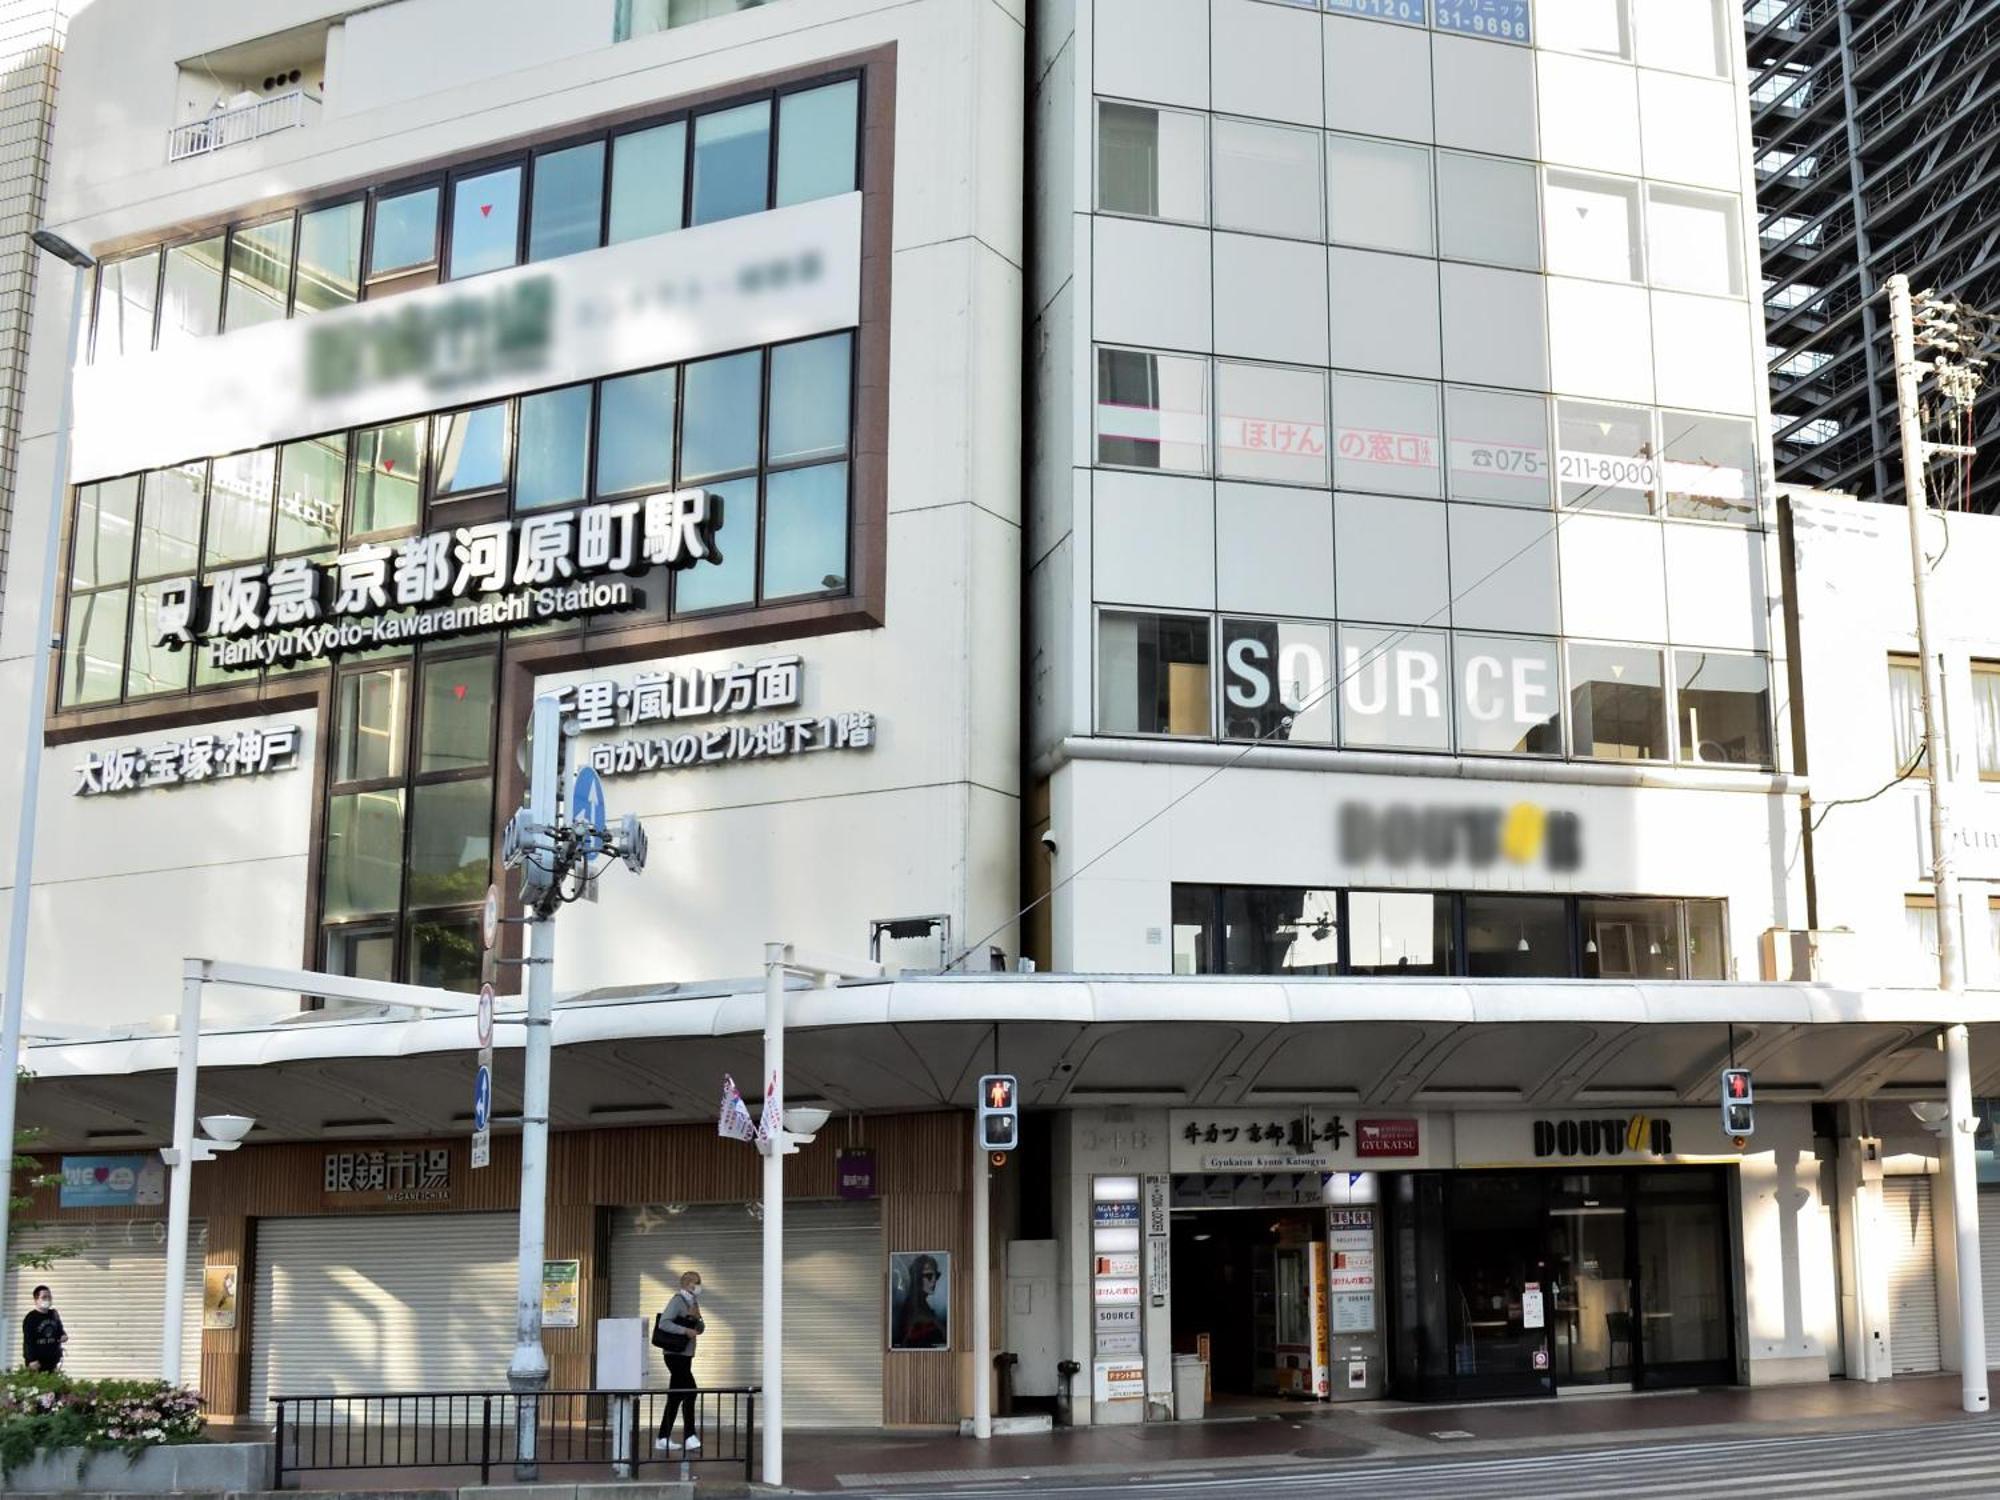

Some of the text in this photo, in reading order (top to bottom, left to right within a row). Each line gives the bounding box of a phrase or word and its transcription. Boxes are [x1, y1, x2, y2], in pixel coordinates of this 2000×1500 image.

[1242, 421, 1420, 464] ほけんの窓口
[211, 582, 627, 667] Hankyu Kyoto-kawaramachi Station
[1226, 638, 1549, 723] SOURCE
[73, 724, 300, 795] 大阪・宝塚・神戸
[589, 711, 876, 775] 向かいのビル地下1階
[1361, 1140, 1416, 1150] GYUKATSU
[1533, 1113, 1672, 1157] DOUTOR
[64, 1167, 95, 1186] WE
[324, 1150, 448, 1192] 眼鏡市場
[1211, 1157, 1253, 1168] Gyukatsu
[1100, 1311, 1135, 1321] SOURCE
